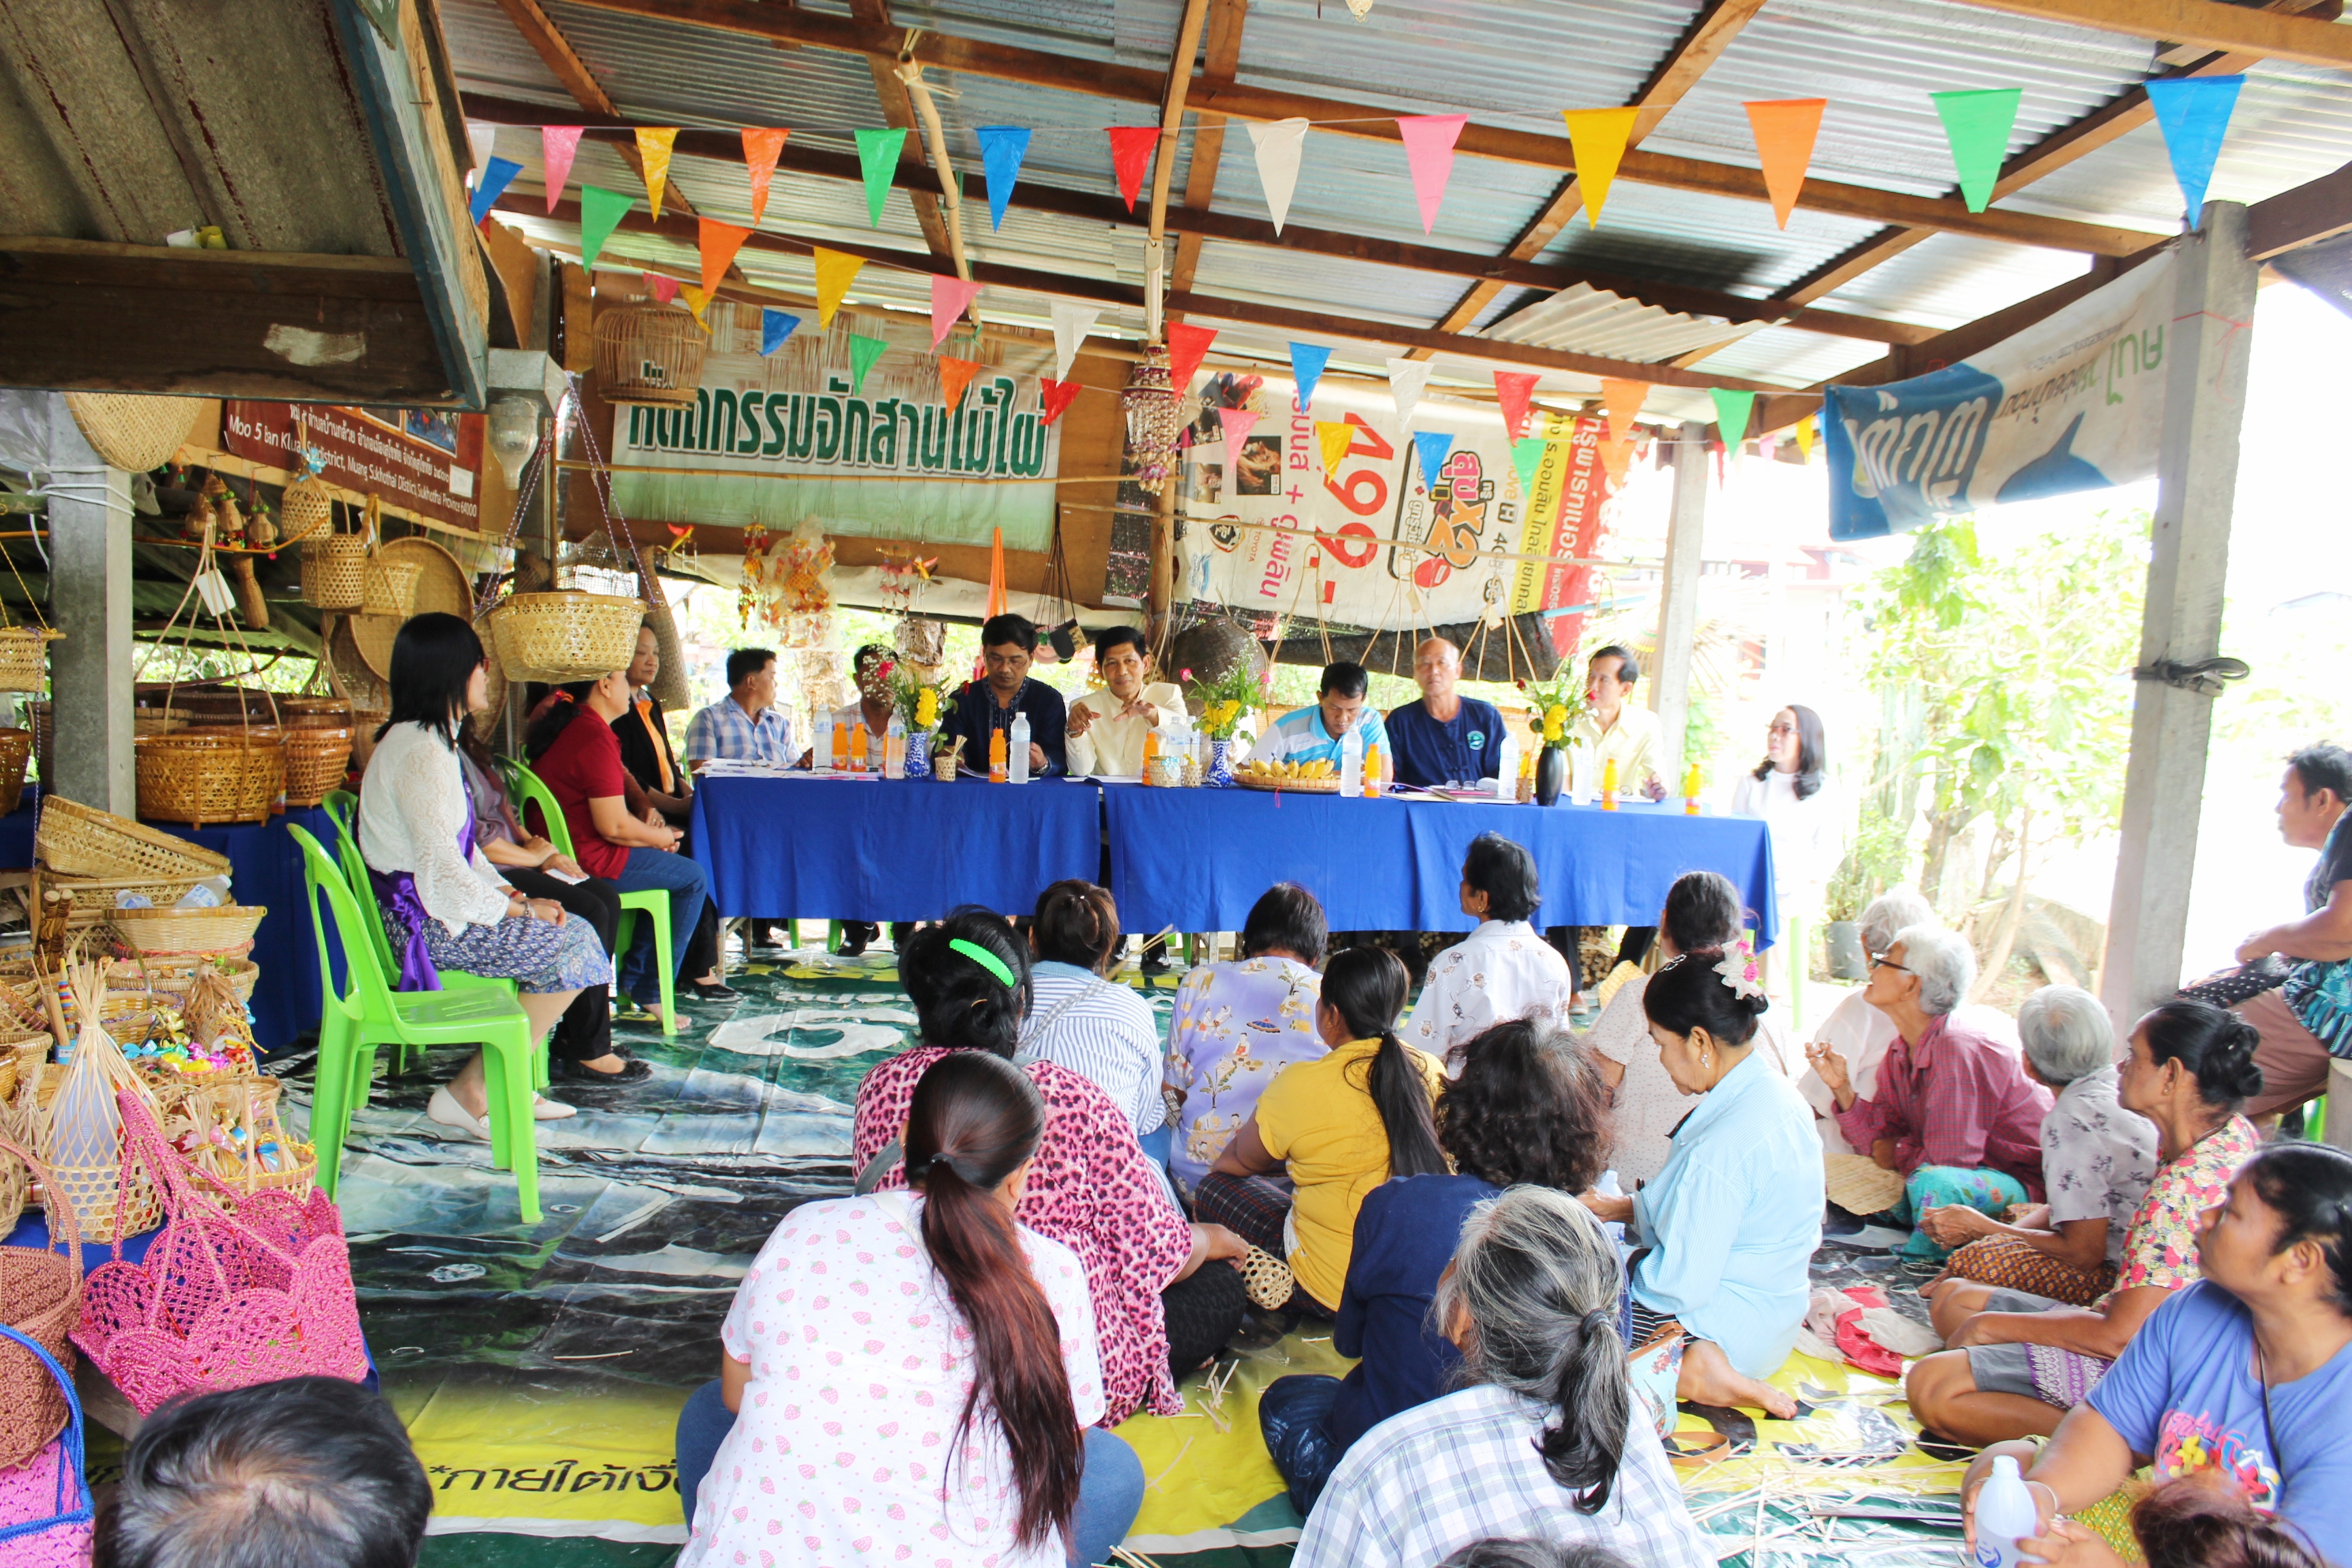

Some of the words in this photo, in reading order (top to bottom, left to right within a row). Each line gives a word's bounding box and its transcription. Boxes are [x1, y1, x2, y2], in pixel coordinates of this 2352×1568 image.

[229, 414, 251, 438] Moo
[254, 422, 263, 440] 5
[265, 425, 278, 446] Ban
[281, 432, 302, 453] Klua
[307, 440, 346, 472] Sdistrict,
[348, 455, 368, 481] Muang
[369, 464, 397, 488] Sukhothai
[417, 484, 442, 505] Sukhothai
[442, 493, 461, 512] Province
[461, 501, 477, 517] 64000
[1247, 531, 1261, 562] TOYOTA
